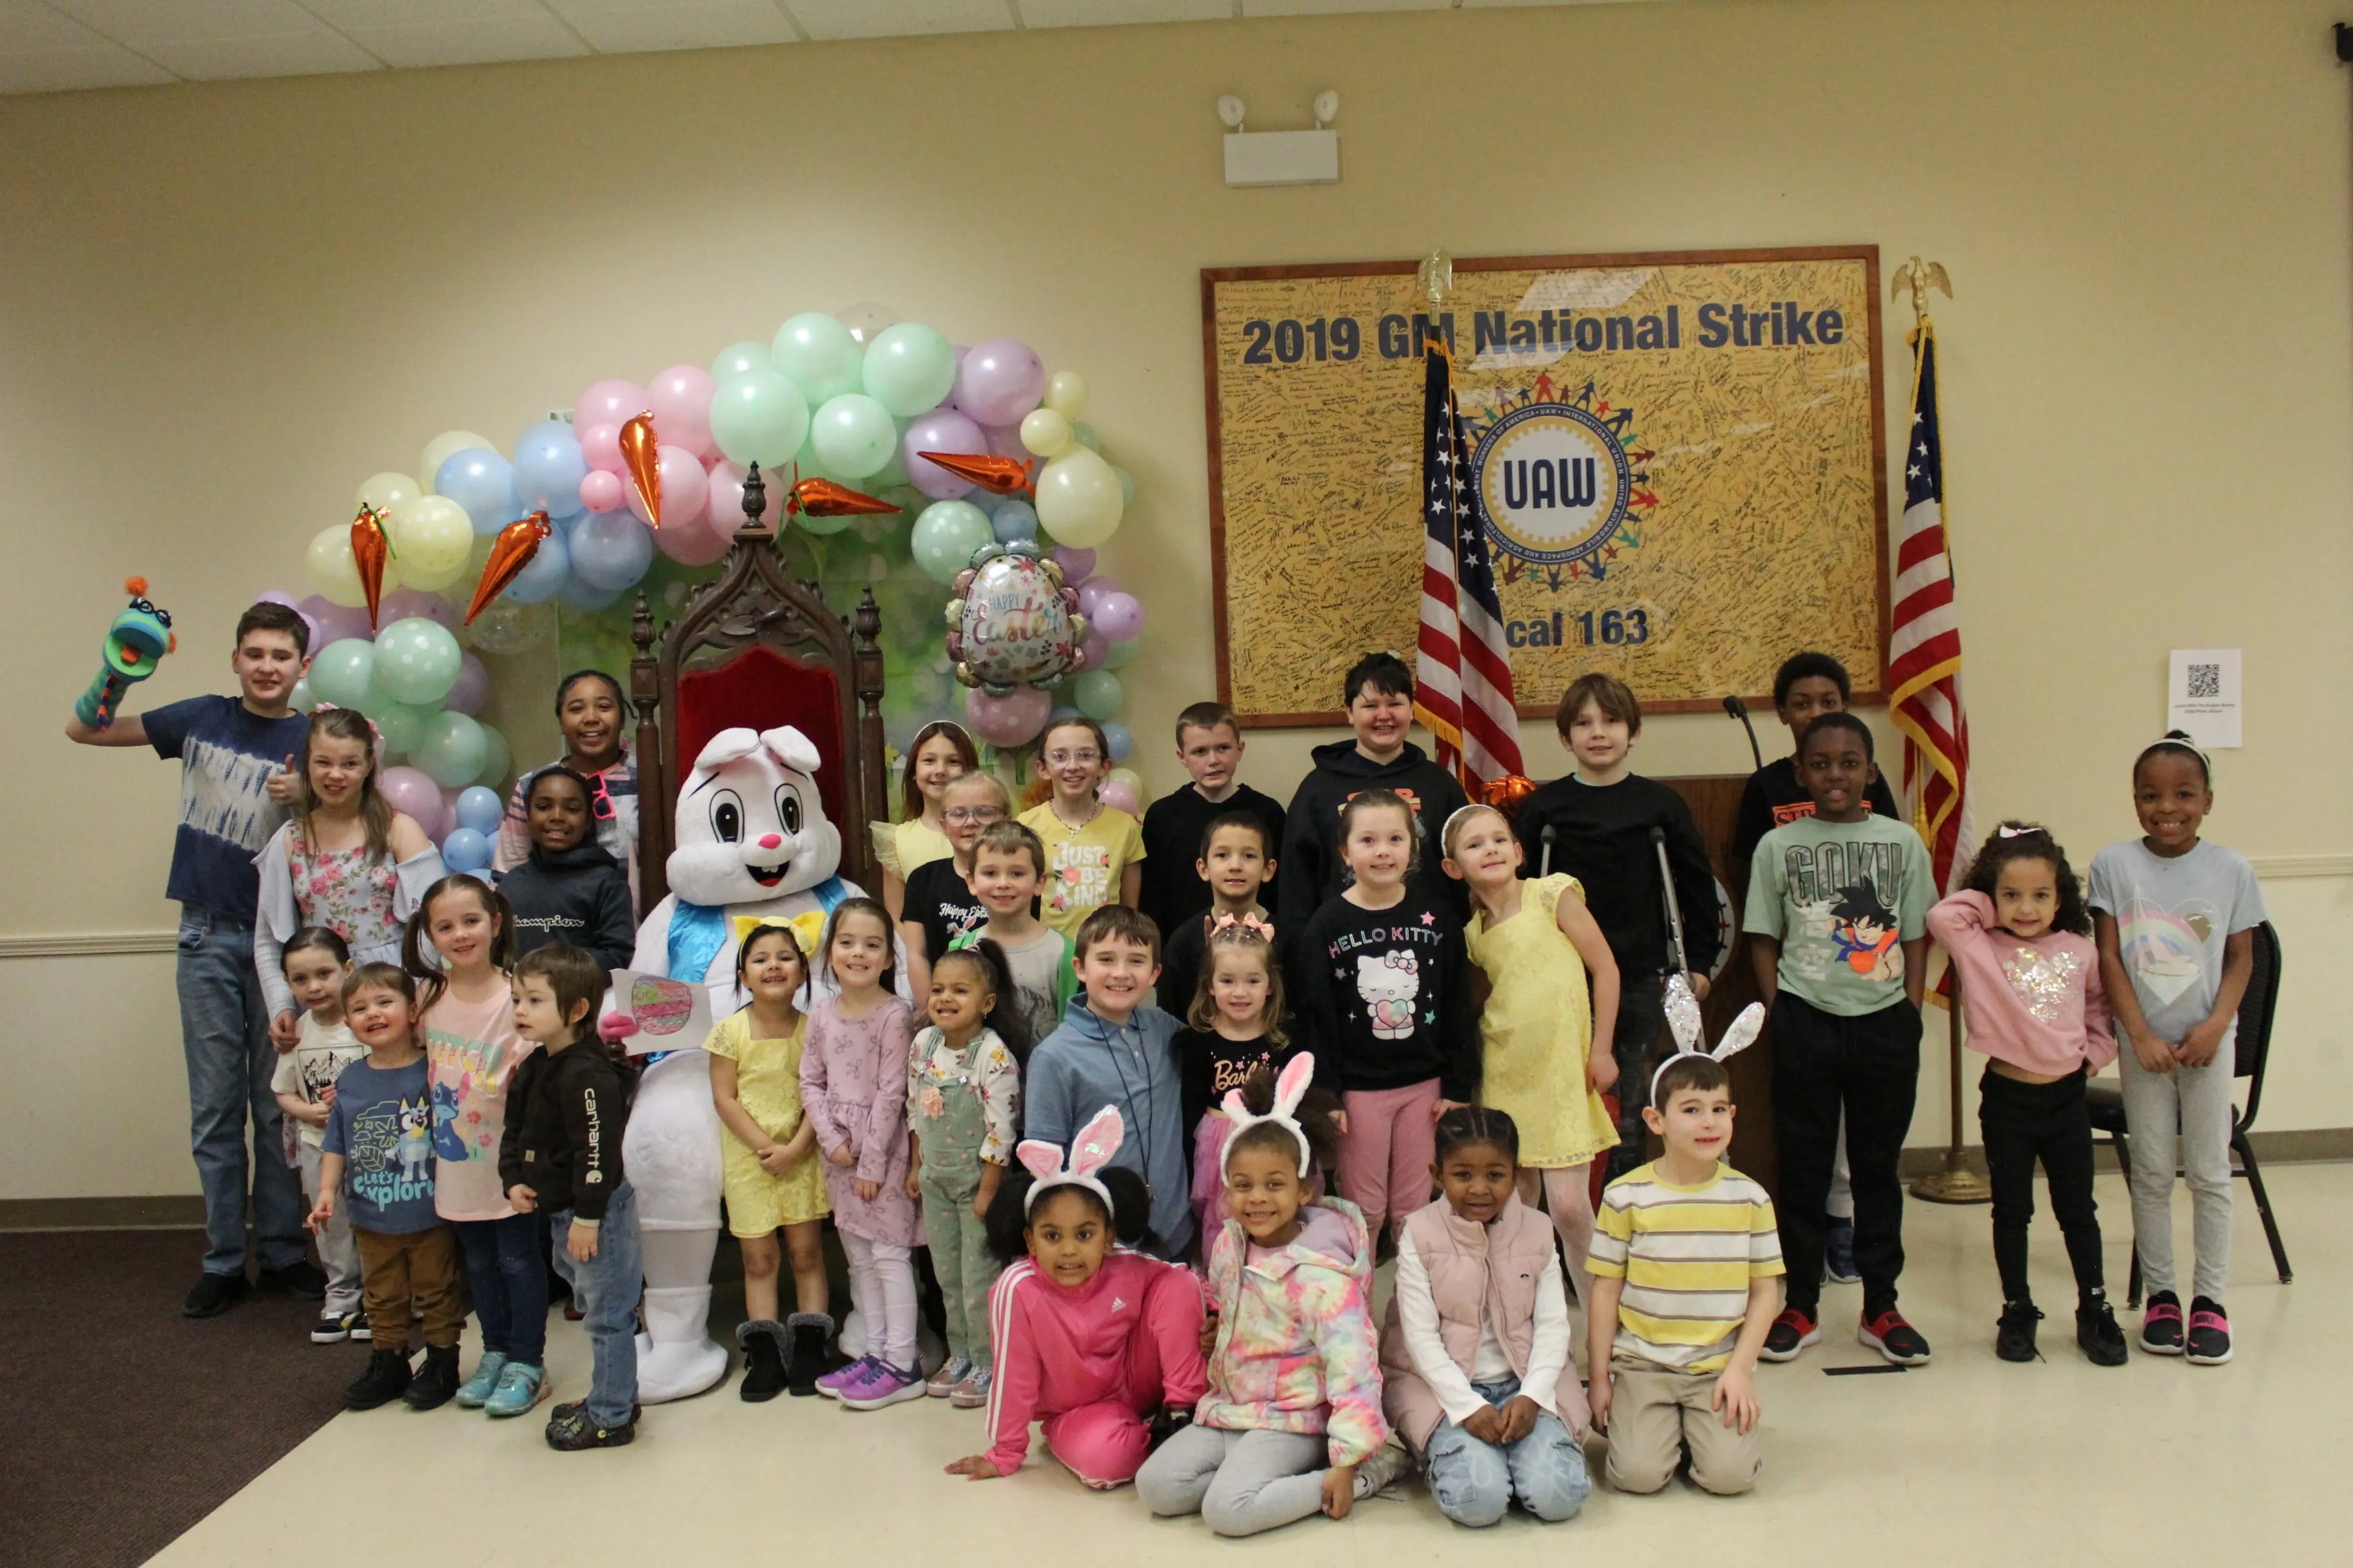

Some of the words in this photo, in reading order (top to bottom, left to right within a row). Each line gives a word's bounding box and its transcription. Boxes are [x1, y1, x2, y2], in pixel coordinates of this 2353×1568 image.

[1243, 317, 1360, 364] 2019
[1379, 312, 1455, 358] GM
[1474, 305, 1680, 356] National
[1698, 302, 1844, 348] Strike
[1496, 426, 1505, 434] OF
[1505, 411, 1535, 428] AMERICA
[1563, 410, 1612, 446] INTERNATIONAL
[1477, 434, 1497, 466] WORKERS
[1611, 448, 1623, 475] UNION
[1504, 457, 1596, 510] UAW
[1616, 480, 1625, 506] UNITED
[1585, 507, 1620, 547] AUTOMOBILE
[1524, 550, 1539, 558] AND
[1543, 546, 1584, 559] AEROSPACE
[989, 593, 1020, 611] HAPPY
[971, 596, 1061, 645] Easter
[1506, 612, 1562, 648] cal
[1578, 609, 1648, 645] 163
[1052, 842, 1106, 871] JUST
[1080, 867, 1108, 885] BE
[1785, 842, 1902, 907] GOKU
[1056, 880, 1108, 906] KIND
[513, 914, 585, 932] hampion
[939, 903, 968, 922] Happy
[1328, 928, 1386, 959] HELLO
[1391, 927, 1443, 945] KITTY
[1214, 1060, 1258, 1091] Bar
[584, 1088, 600, 1168] carhartt
[364, 1171, 394, 1185] Let's
